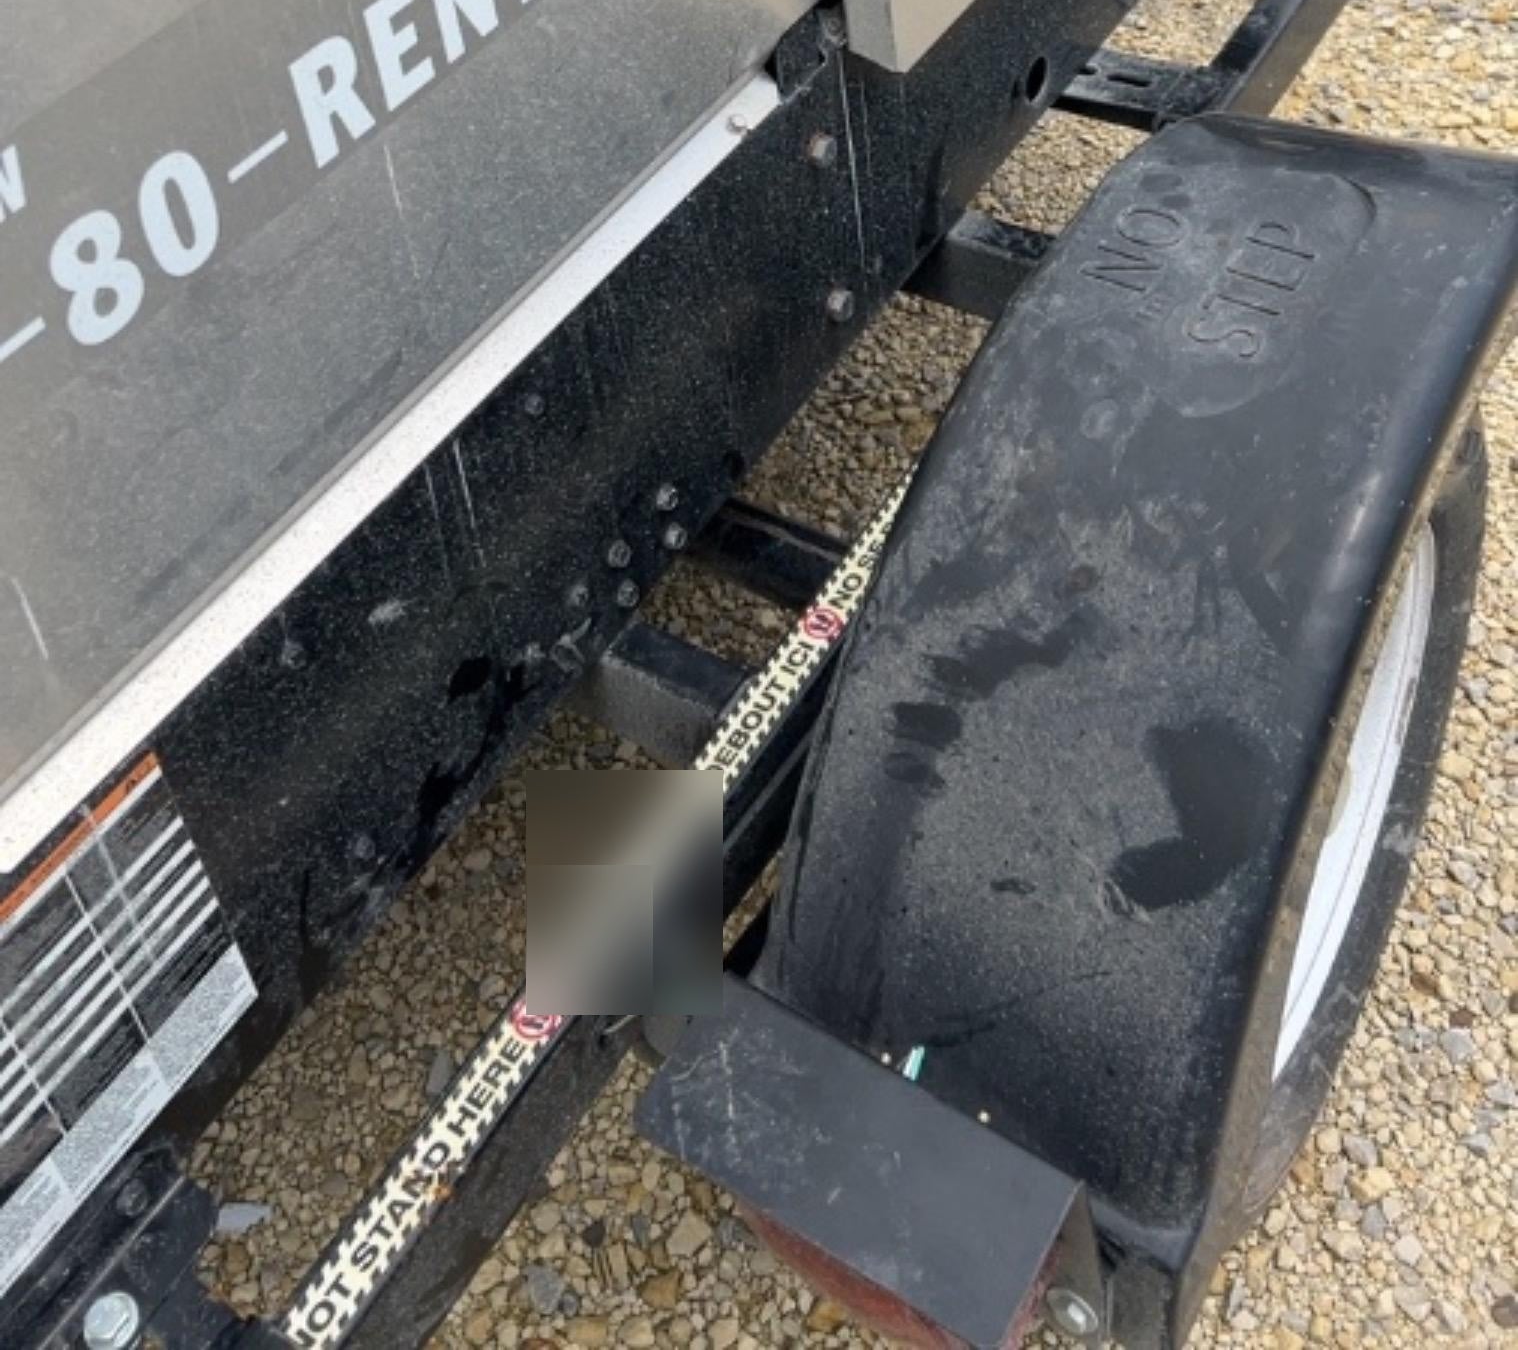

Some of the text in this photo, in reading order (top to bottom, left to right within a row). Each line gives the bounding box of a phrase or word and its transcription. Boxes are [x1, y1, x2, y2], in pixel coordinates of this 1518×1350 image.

[1079, 205, 1190, 293] NO
[1183, 220, 1316, 360] STEP
[828, 572, 863, 608] NO
[705, 676, 786, 771] EBOUT
[350, 1140, 451, 1273] STAND
[447, 1036, 526, 1138] HERE
